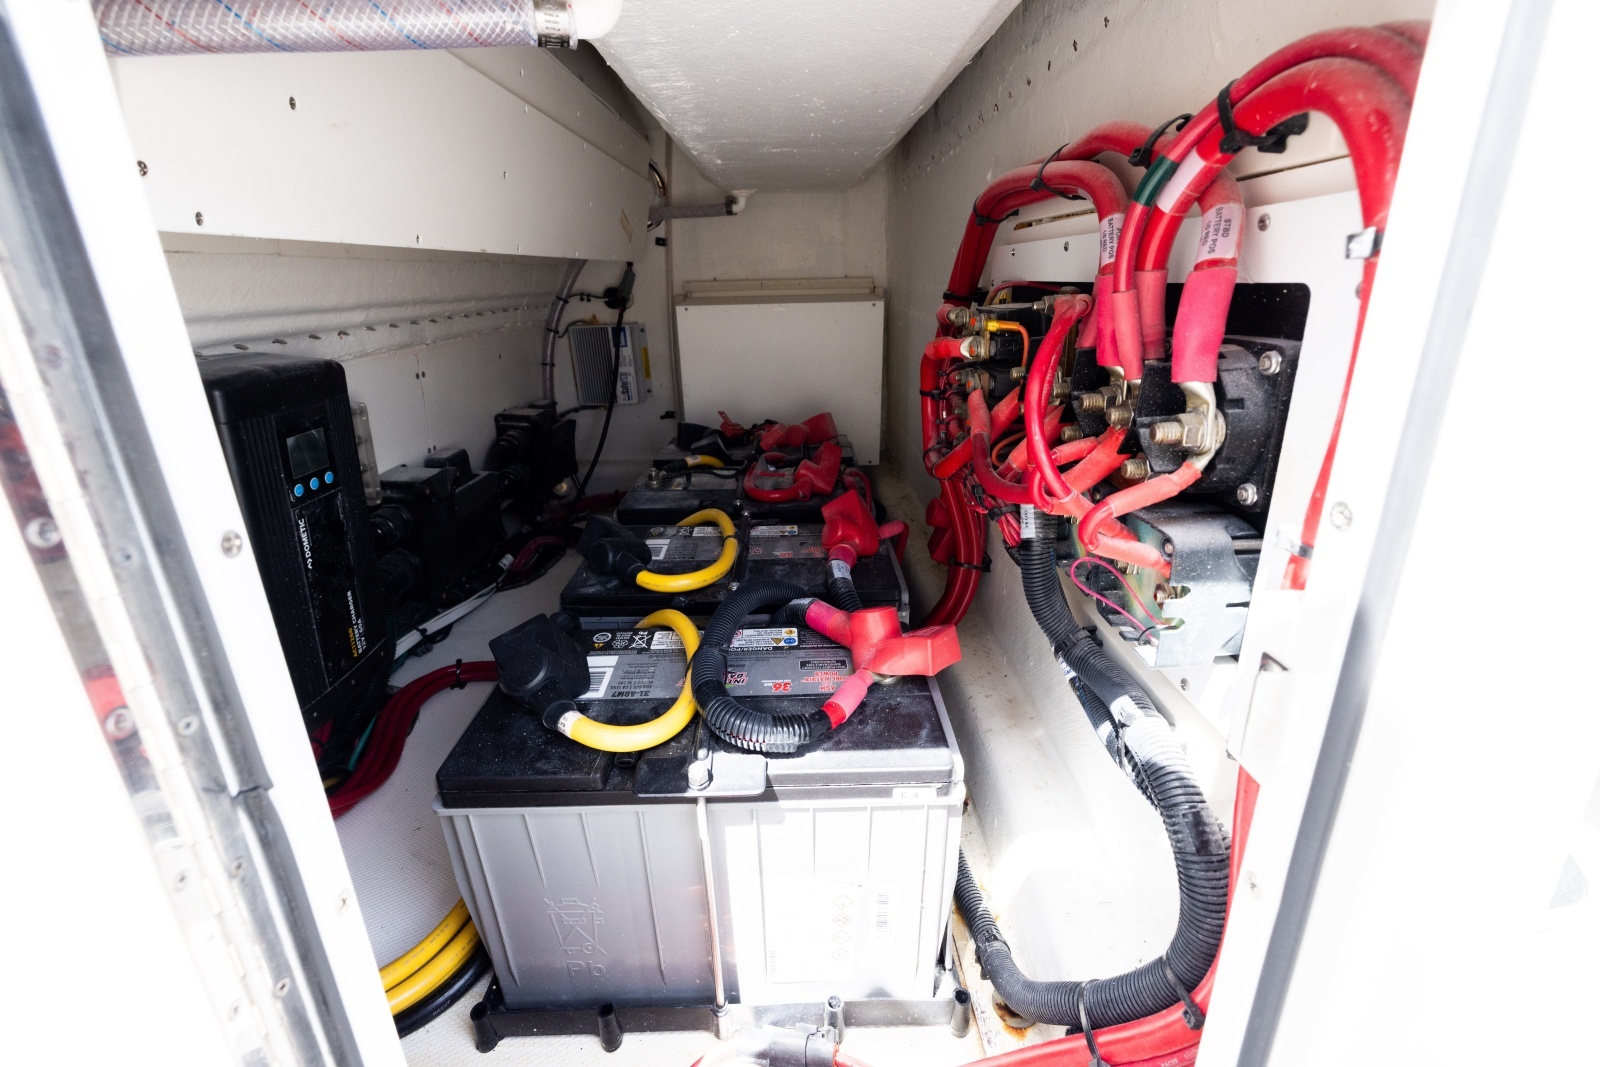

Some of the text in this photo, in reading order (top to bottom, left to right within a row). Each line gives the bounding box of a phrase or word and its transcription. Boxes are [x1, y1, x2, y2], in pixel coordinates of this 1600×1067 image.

[1107, 217, 1115, 244] BATTERY
[1208, 206, 1223, 255] BATTERY POS
[1221, 218, 1232, 238] STBD
[1202, 231, 1210, 246] RED
[298, 518, 312, 558] DOMETIC
[346, 590, 363, 654] BATTERY CHARGER
[359, 637, 367, 650] 12V
[610, 690, 651, 698] 31-AGM7
[771, 682, 793, 693] 36
[566, 960, 606, 977] Pb
[769, 950, 777, 978] DANGER
